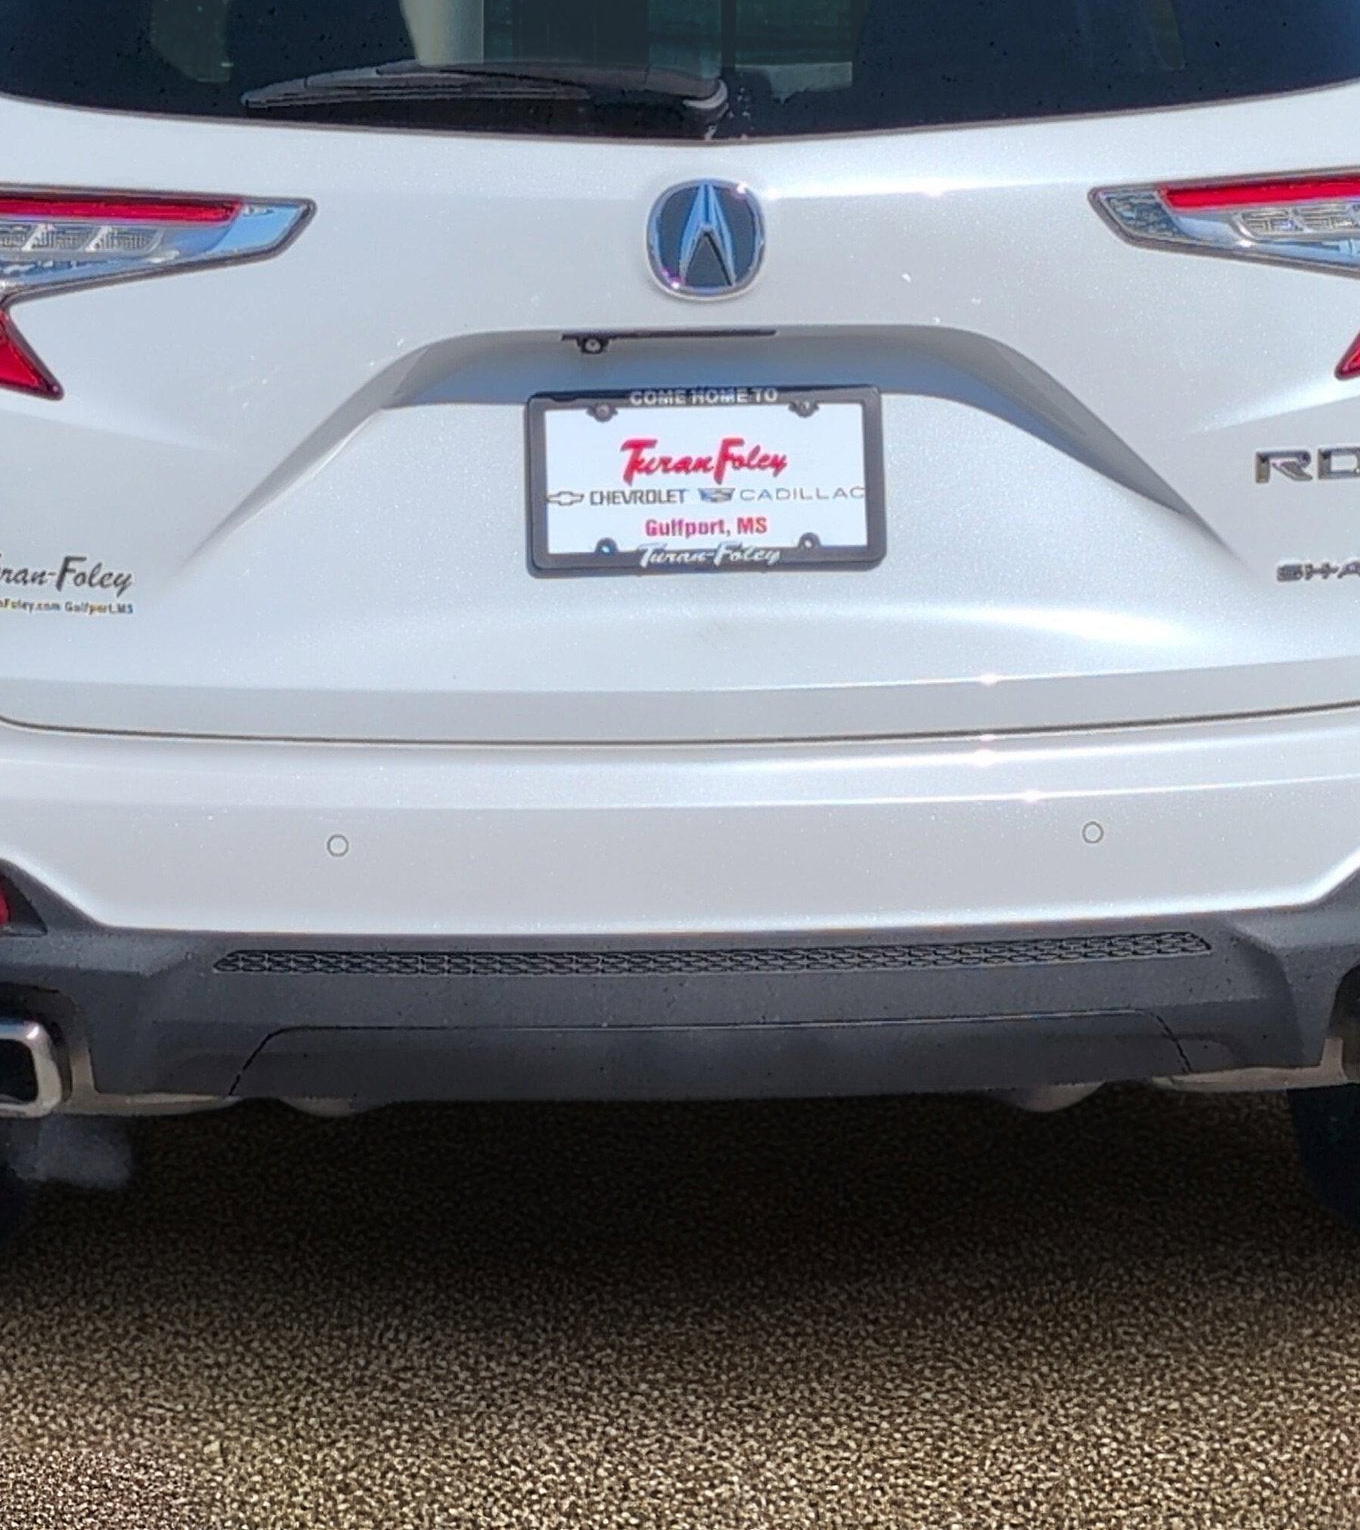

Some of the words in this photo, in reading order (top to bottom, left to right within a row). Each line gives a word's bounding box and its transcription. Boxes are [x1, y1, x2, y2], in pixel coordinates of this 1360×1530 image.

[629, 390, 686, 406] COME
[691, 388, 748, 405] HOME
[753, 387, 779, 403] TO
[590, 488, 690, 506] CHEVROLET
[740, 486, 866, 502] CADILLAC
[645, 518, 731, 538] Gulfport,
[736, 516, 768, 535] MS
